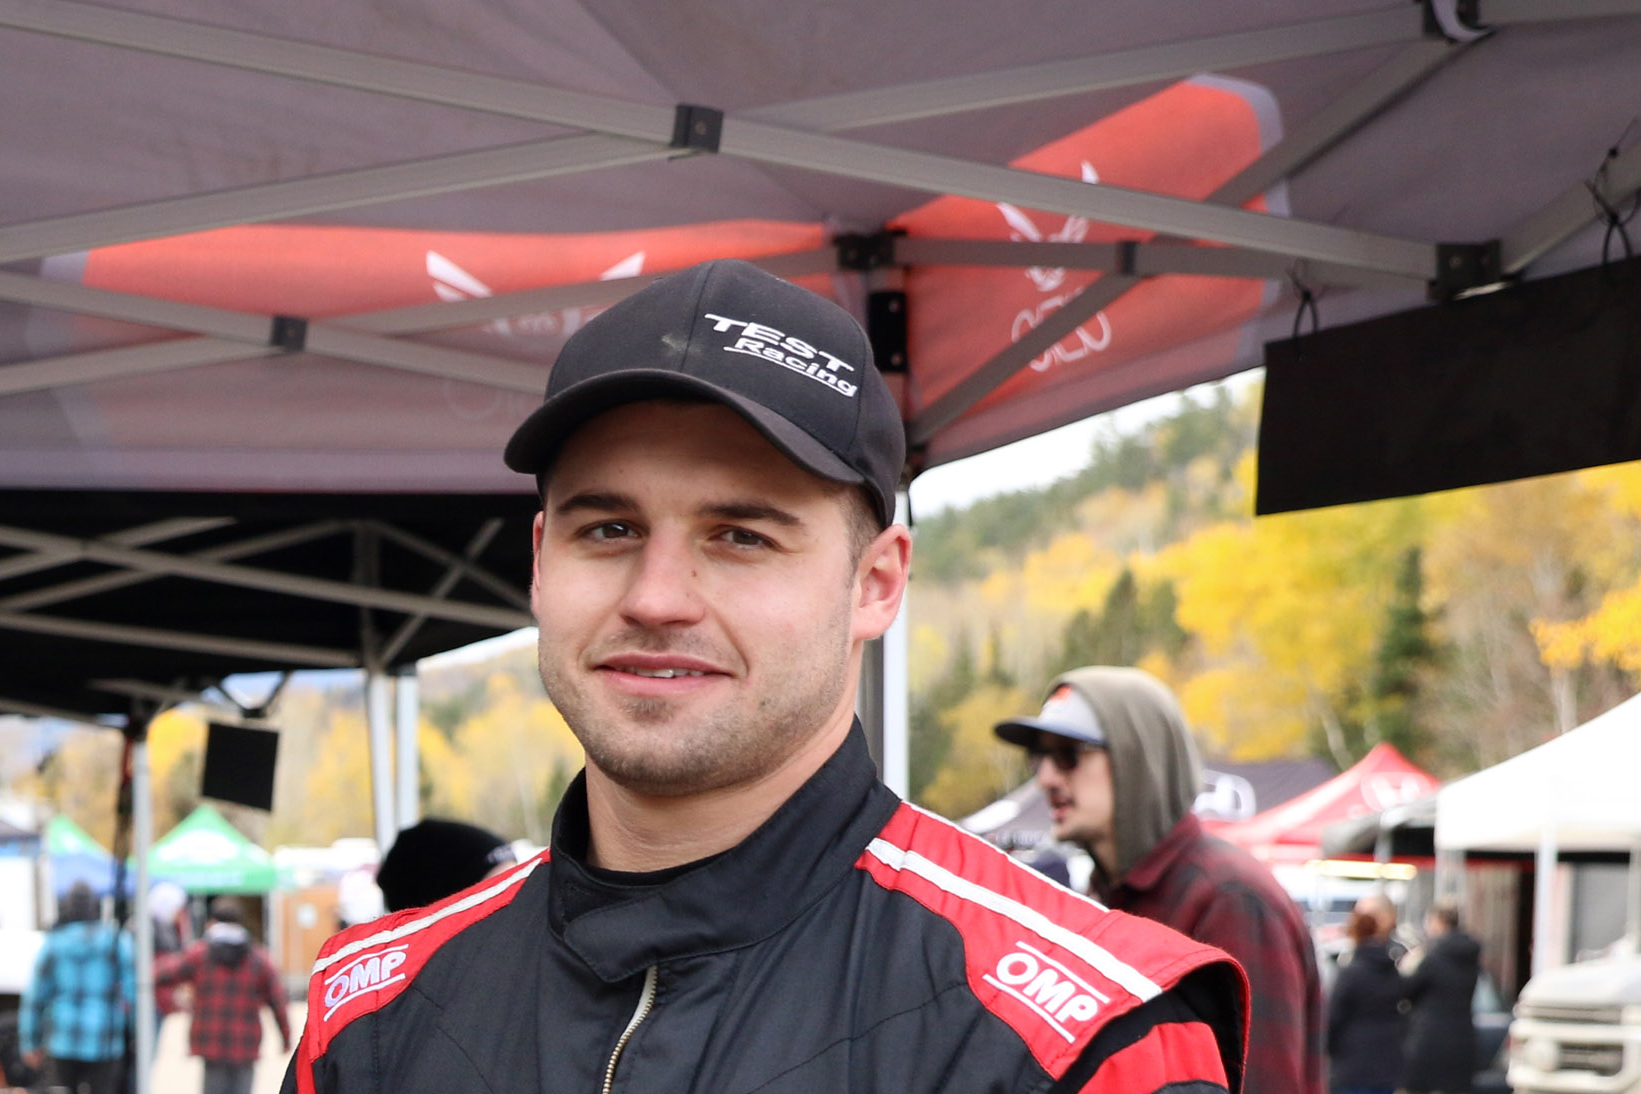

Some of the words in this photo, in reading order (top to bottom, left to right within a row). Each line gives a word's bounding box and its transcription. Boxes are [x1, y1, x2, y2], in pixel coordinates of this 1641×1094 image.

[704, 303, 855, 372] TEST
[733, 337, 858, 398] Racing
[324, 950, 407, 1008] OMP
[995, 952, 1099, 1024] OMP
